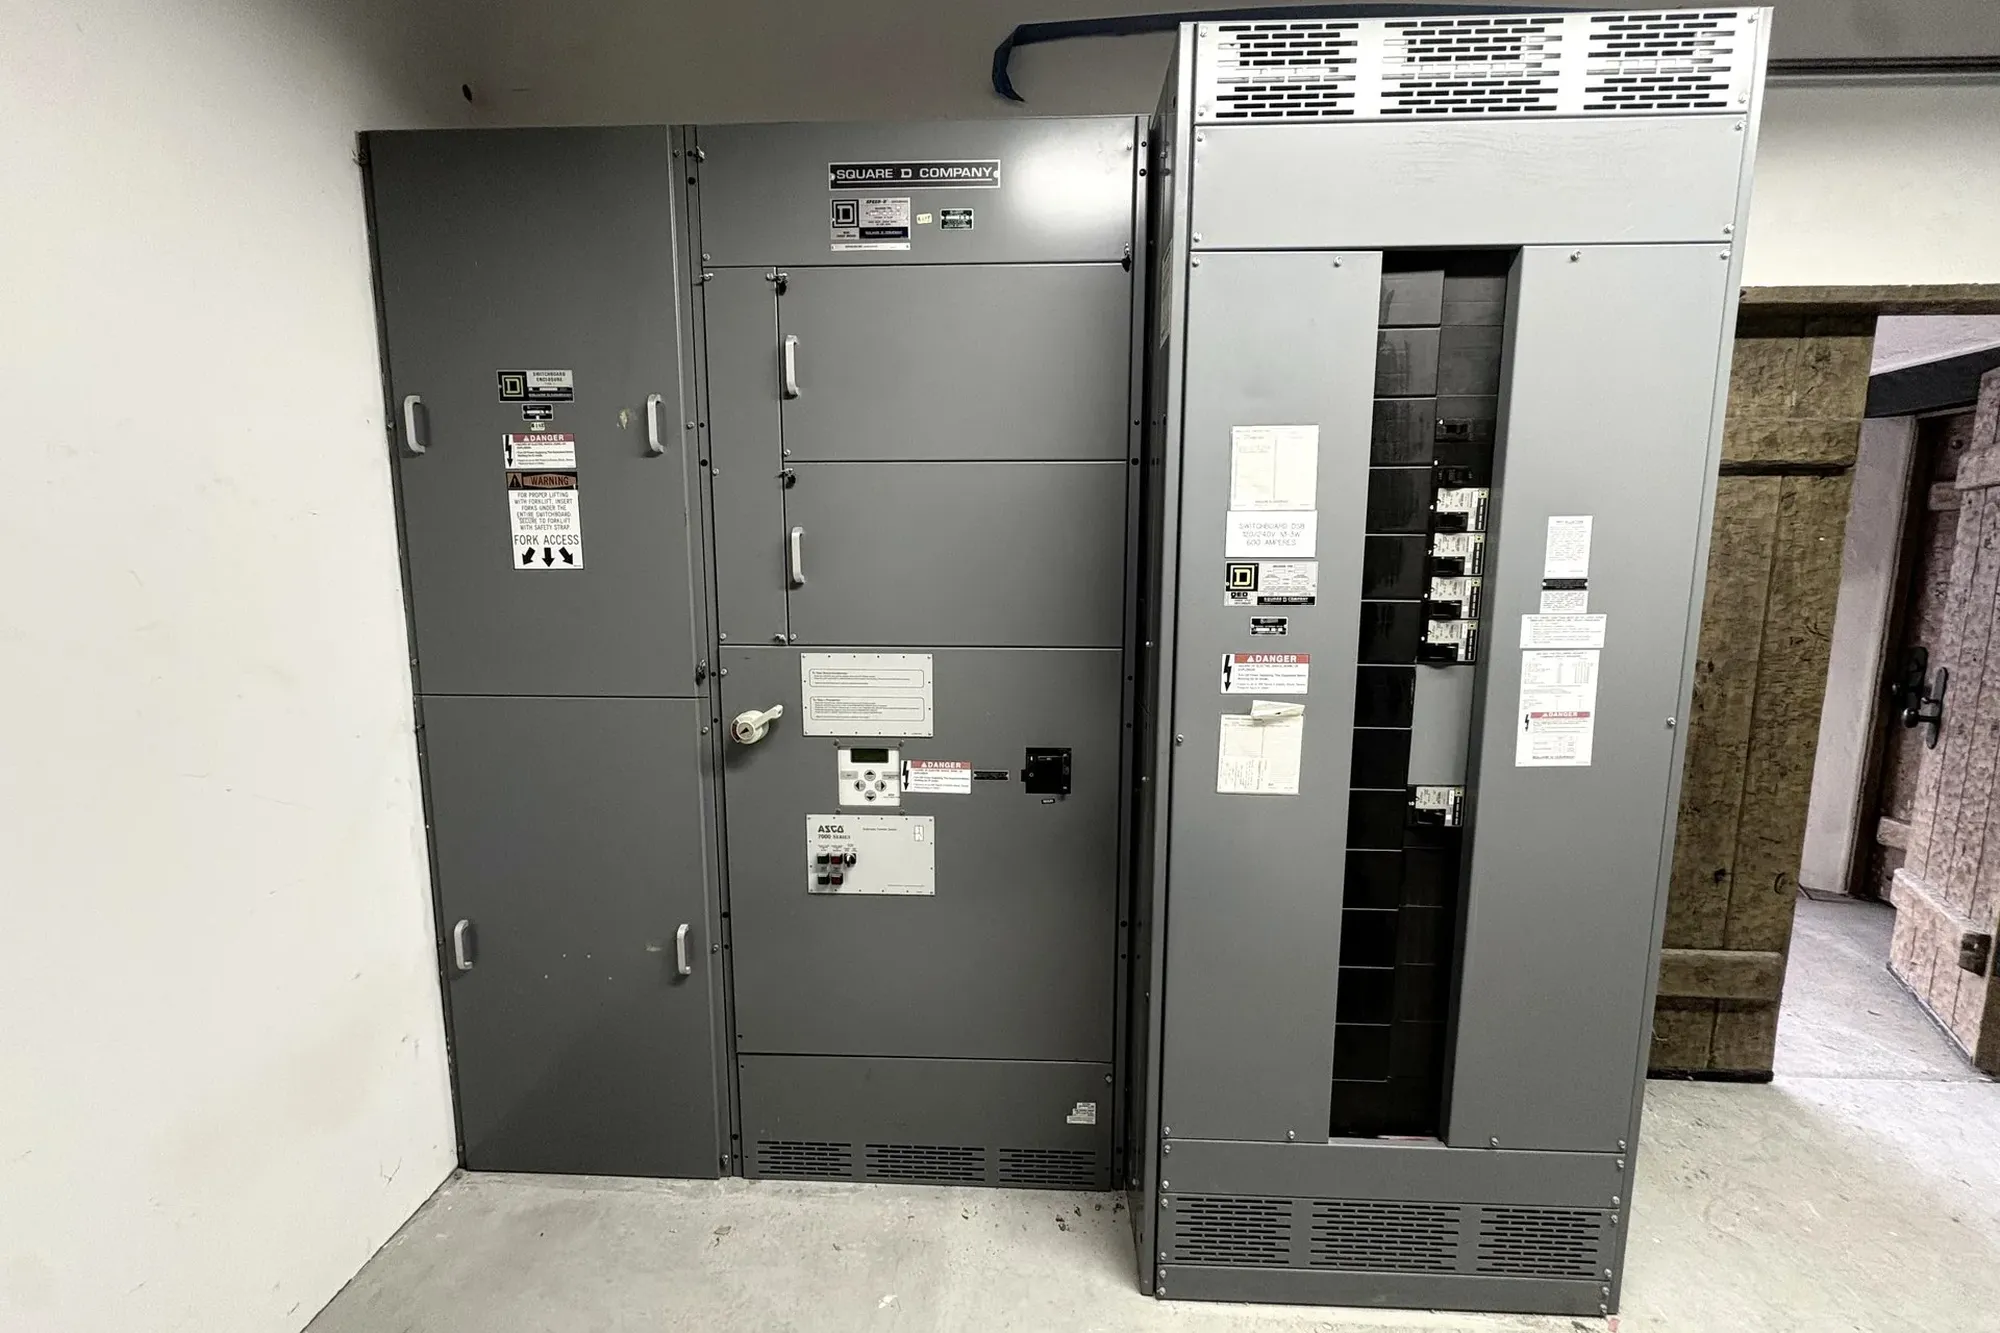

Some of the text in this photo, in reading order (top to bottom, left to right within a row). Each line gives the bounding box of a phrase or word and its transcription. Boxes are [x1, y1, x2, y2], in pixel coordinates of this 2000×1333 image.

[836, 167, 993, 179] SQUARE D COMPANY
[531, 477, 569, 486] WARNING
[514, 535, 580, 546] FORK ACCESS
[1256, 655, 1297, 663] DANGER
[818, 825, 844, 833] ASCO
